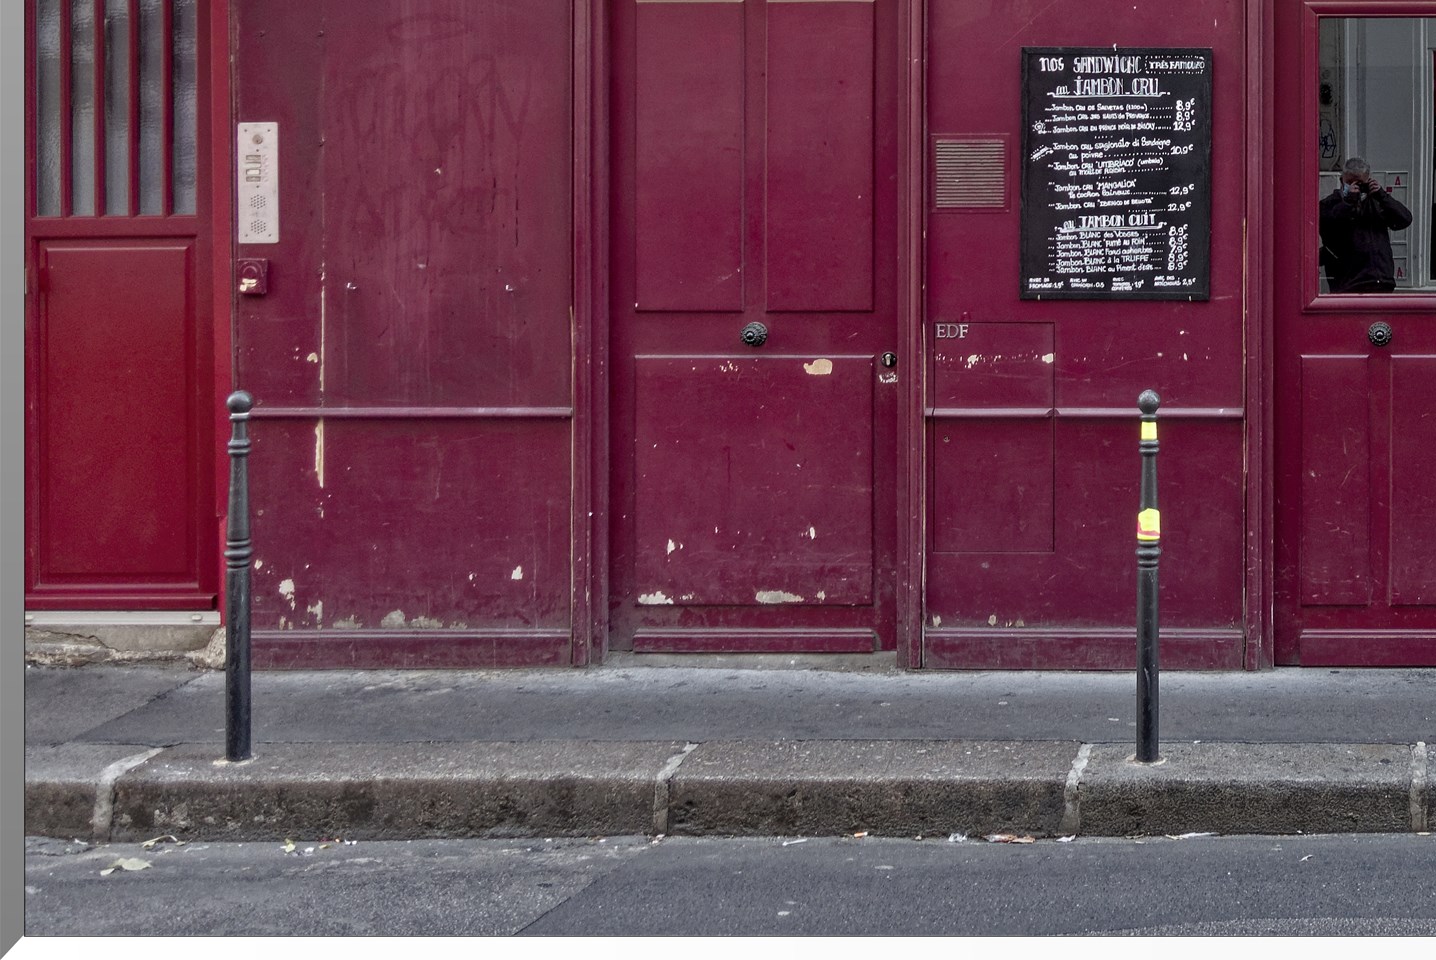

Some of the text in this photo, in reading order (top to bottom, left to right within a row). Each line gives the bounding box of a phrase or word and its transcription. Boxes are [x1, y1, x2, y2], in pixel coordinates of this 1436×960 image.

[1073, 76, 1124, 96] JAMBON
[1131, 77, 1159, 96] CRU
[1078, 214, 1124, 227] JAMBON
[1129, 212, 1155, 225] CUIT
[936, 324, 969, 338] EDF
